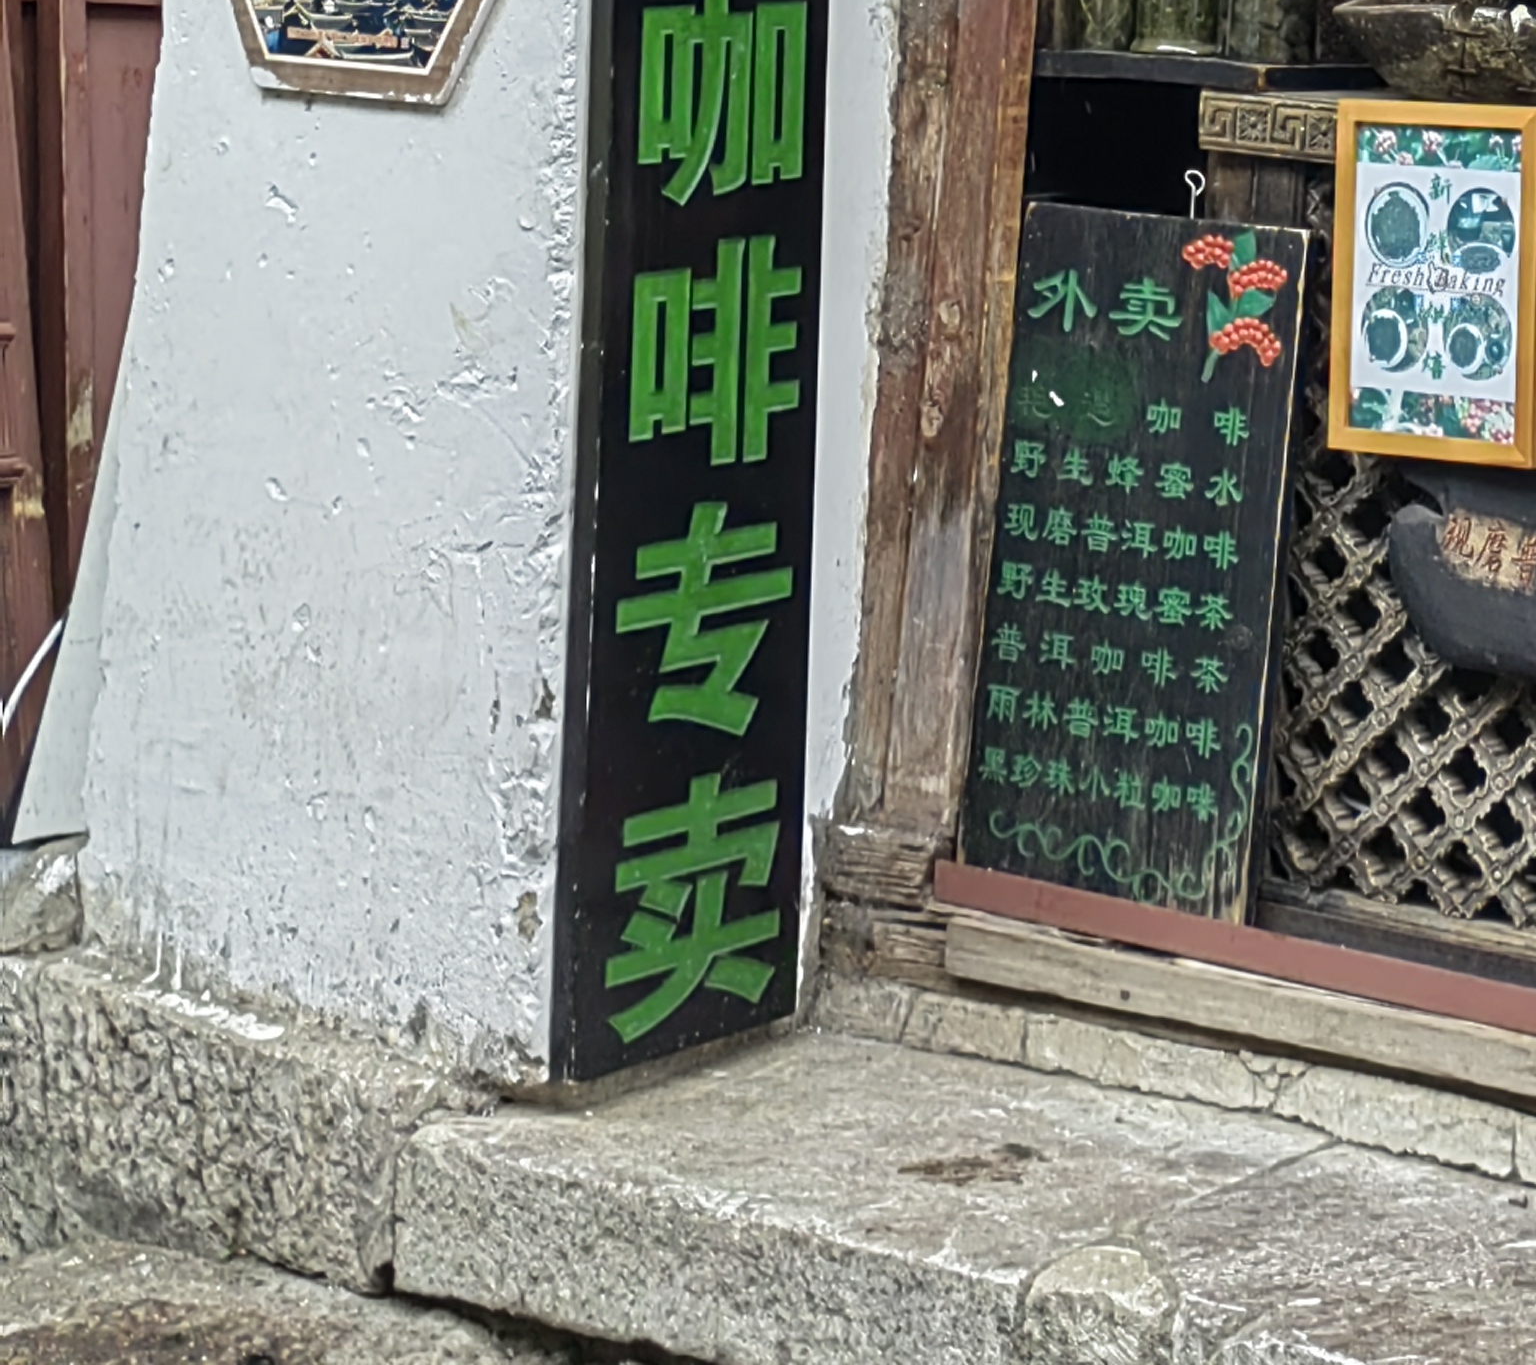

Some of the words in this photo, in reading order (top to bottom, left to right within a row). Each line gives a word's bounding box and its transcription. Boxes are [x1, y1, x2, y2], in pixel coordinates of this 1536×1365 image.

[1027, 269, 1183, 341] 外卖
[1010, 439, 1244, 507] 野生蜂蜜水
[1004, 503, 1239, 571] 现磨普洱咖啡
[996, 560, 1233, 631] 野生玫瑰蜜茶
[991, 622, 1229, 694] 普洱咖啡茶
[986, 683, 1222, 759] 雨林普洱咖啡
[978, 745, 1218, 822] 黑珍珠小粒咖啡
